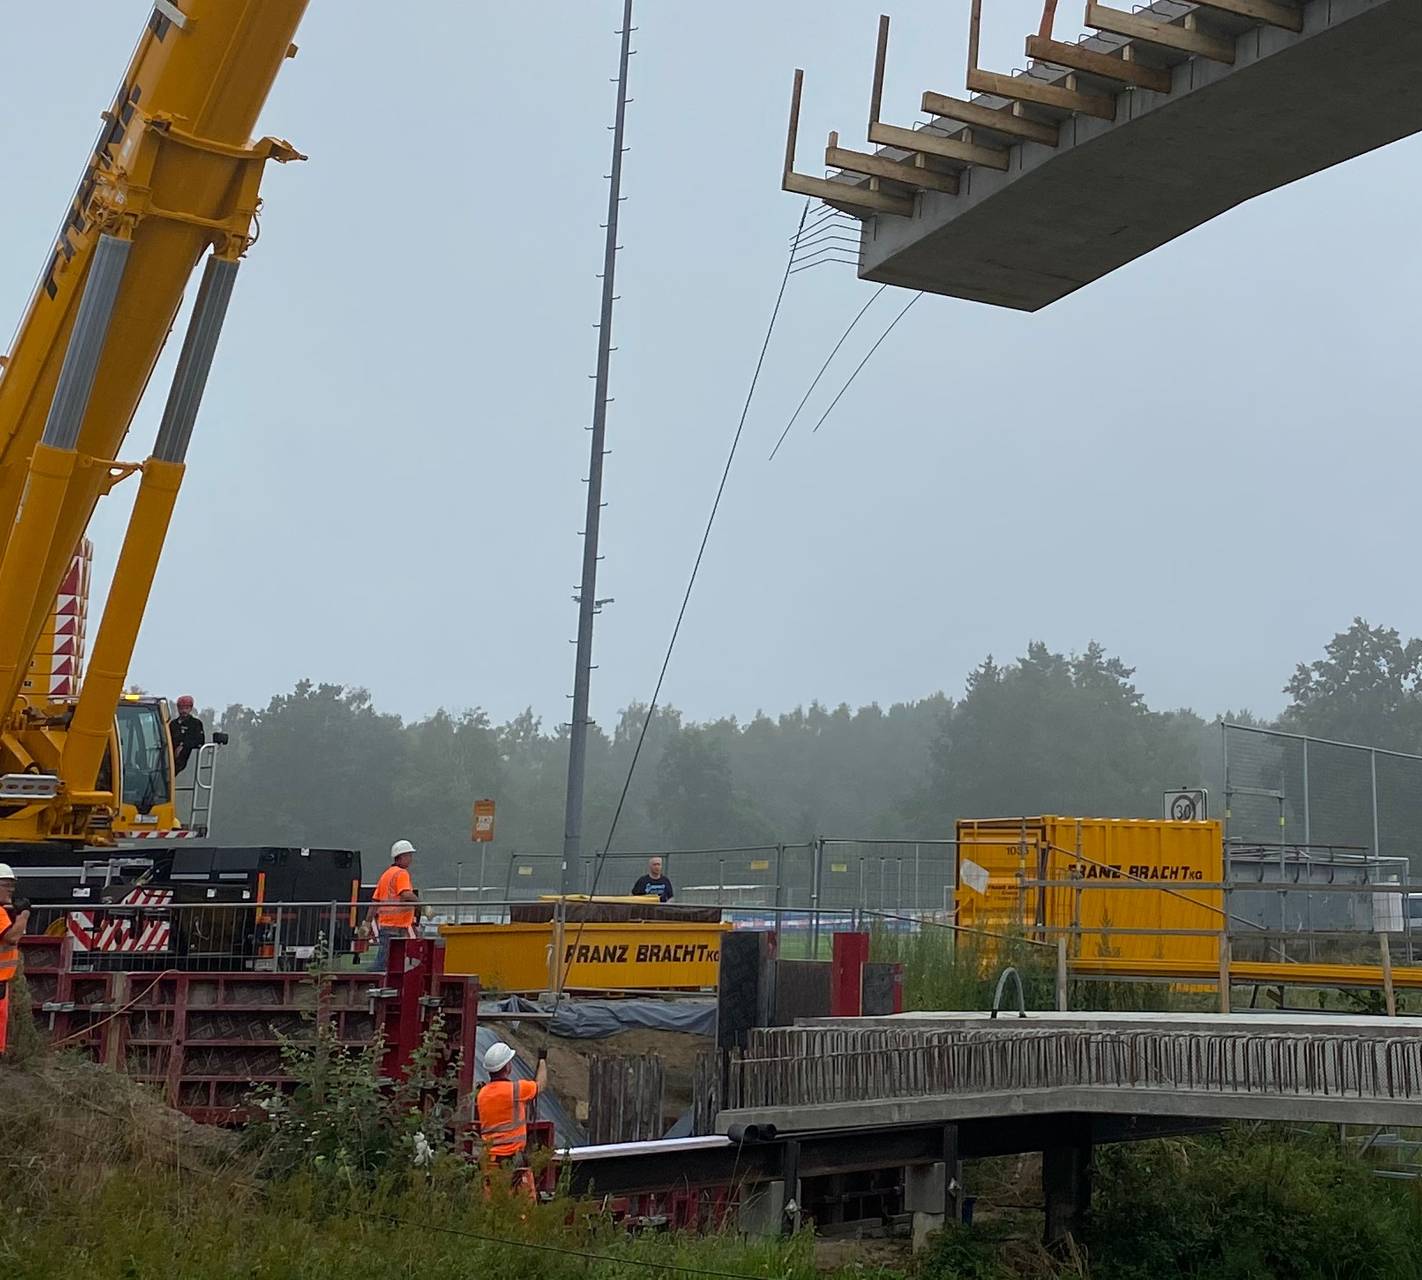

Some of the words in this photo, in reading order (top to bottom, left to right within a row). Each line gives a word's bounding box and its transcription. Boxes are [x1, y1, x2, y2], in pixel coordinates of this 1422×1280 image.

[1176, 804, 1191, 820] 30
[1128, 864, 1190, 880] BRACHT
[564, 944, 629, 963] FRANZ
[635, 944, 708, 963] BRACHT
